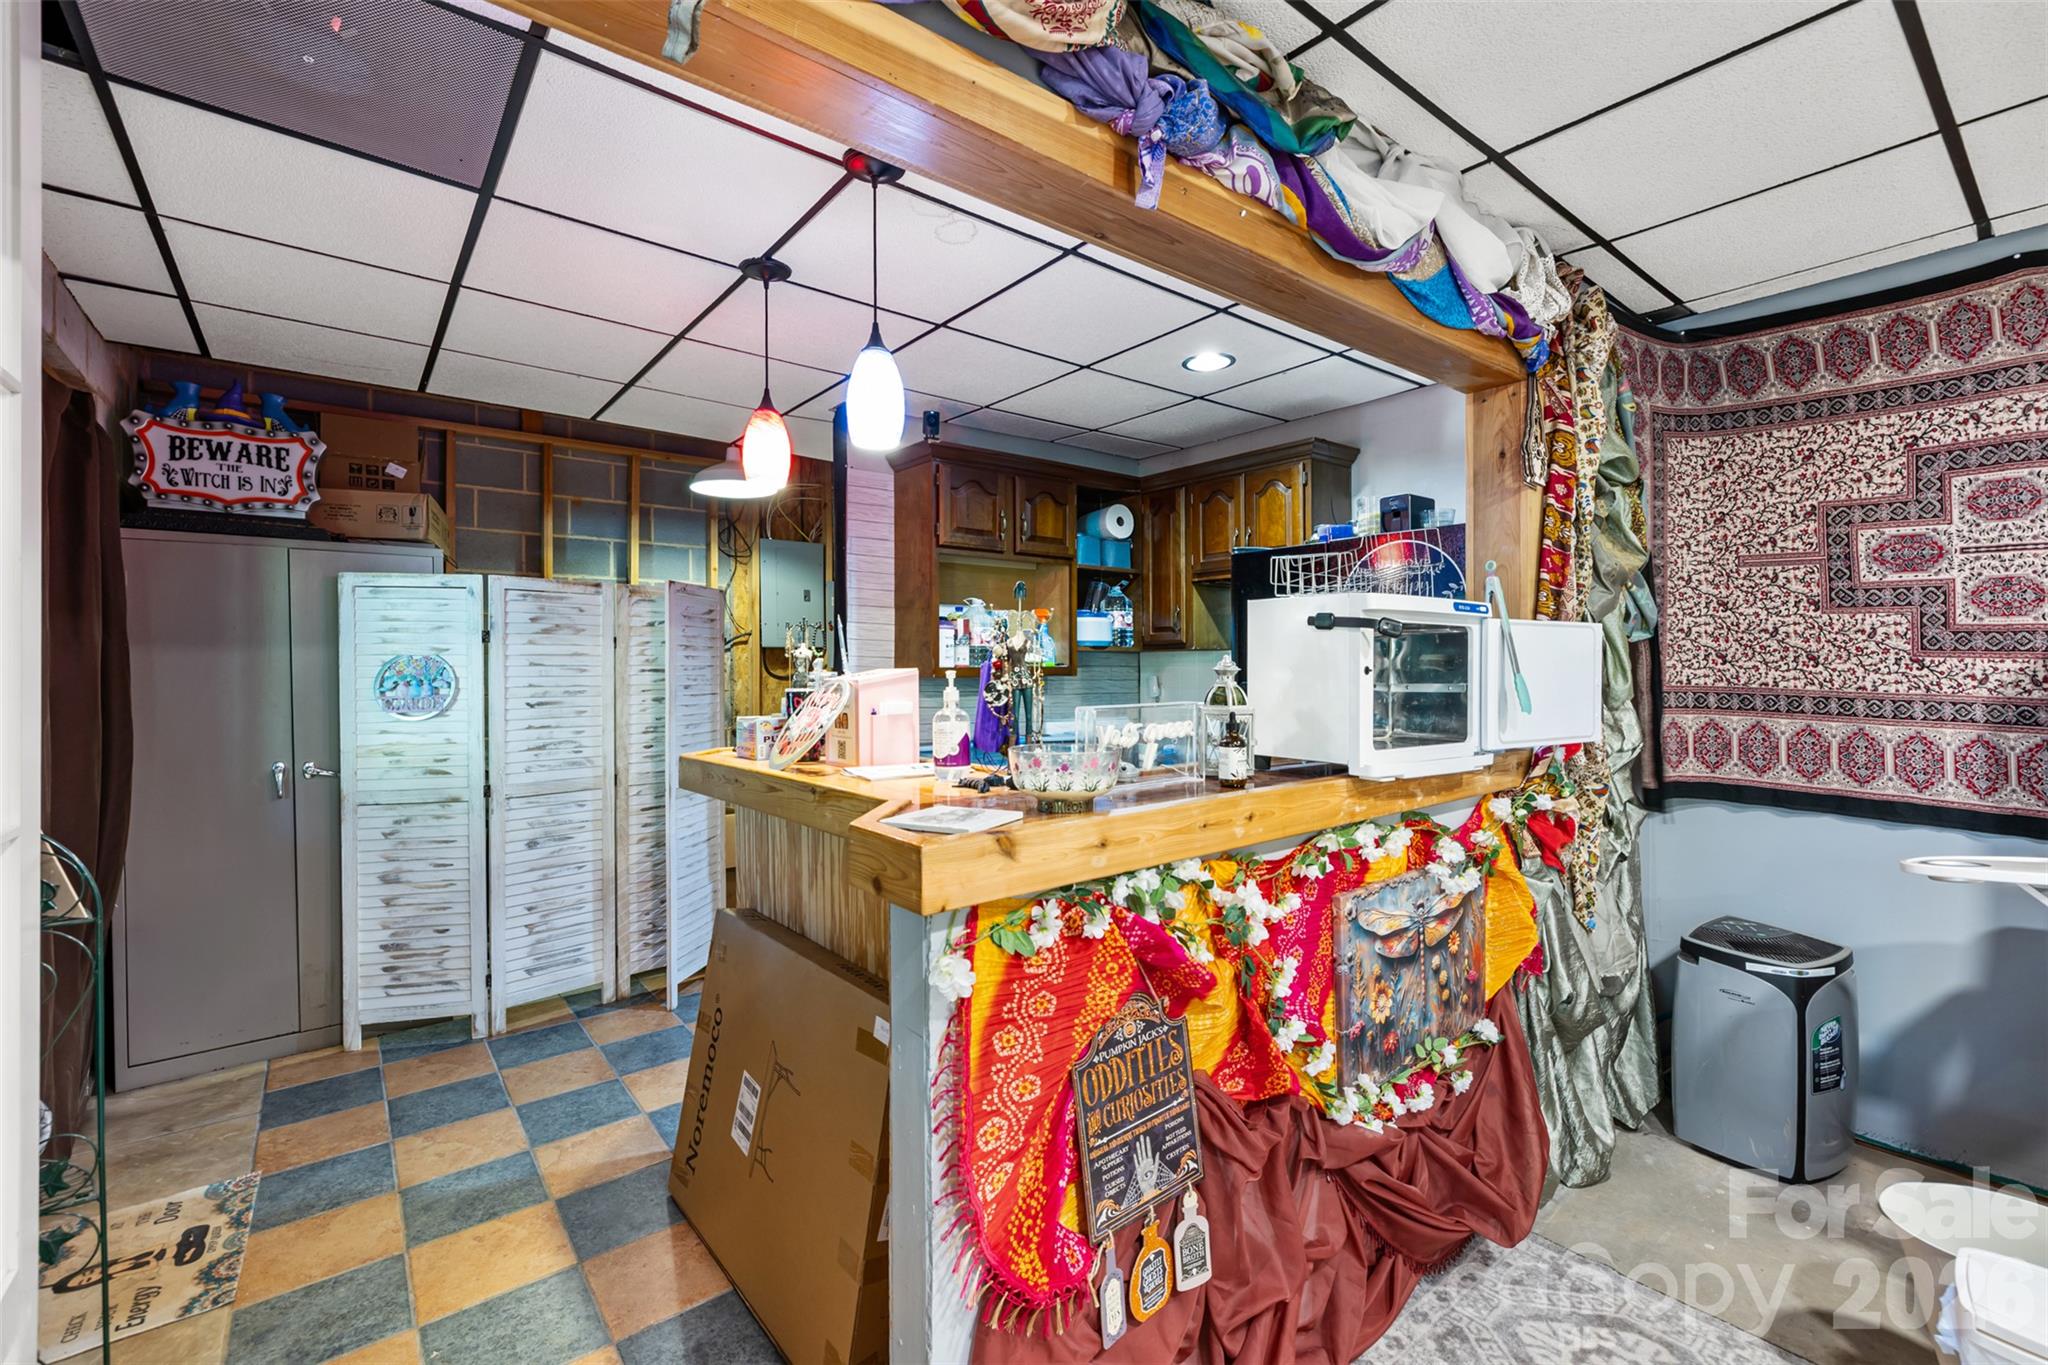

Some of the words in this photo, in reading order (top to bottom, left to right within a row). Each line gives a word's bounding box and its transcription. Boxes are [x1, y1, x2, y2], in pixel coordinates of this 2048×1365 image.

[167, 434, 291, 472] BEWARE
[216, 462, 244, 474] THE
[180, 468, 231, 490] WITCH
[237, 475, 254, 491] IS
[260, 475, 278, 493] IN
[1098, 1037, 1137, 1062] PUMPKIN
[1082, 1029, 1184, 1107] ODDITIES
[685, 1006, 724, 1175] Noremoco
[1103, 1068, 1188, 1128] CURIOSITIES
[1094, 1145, 1130, 1170] APOTHECARY
[1102, 1165, 1125, 1182] POTIONS
[115, 1286, 162, 1332] Energy
